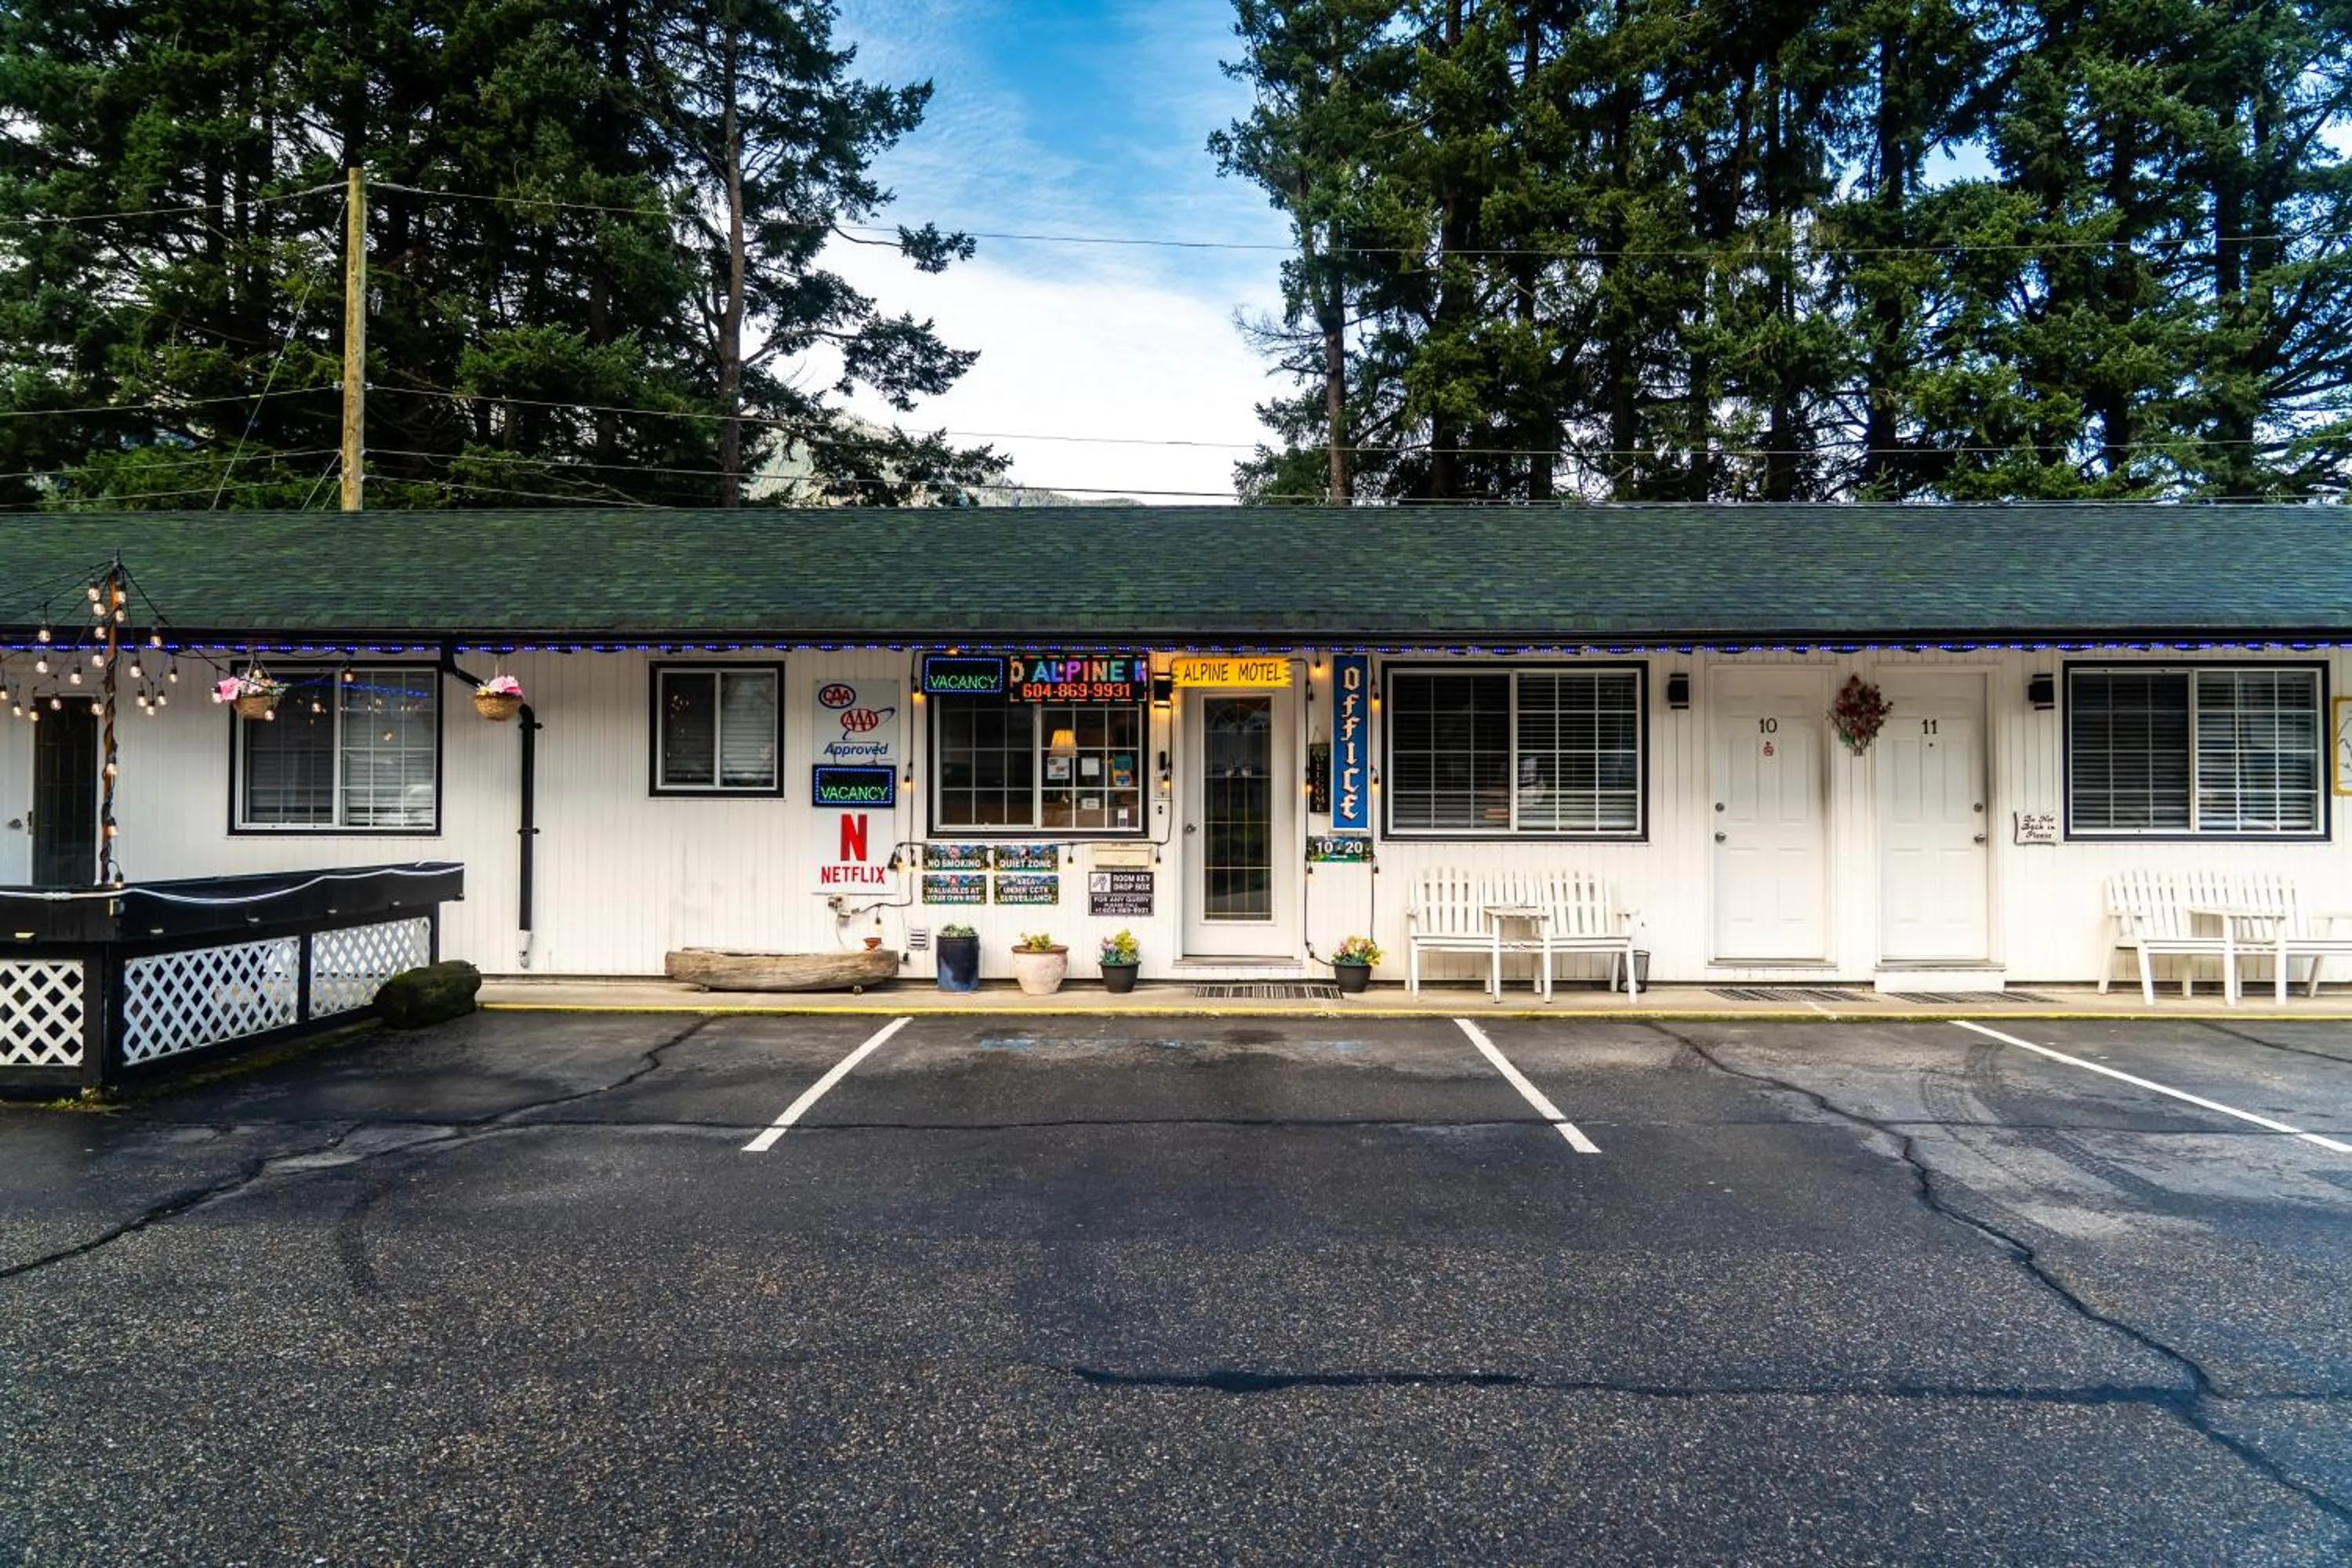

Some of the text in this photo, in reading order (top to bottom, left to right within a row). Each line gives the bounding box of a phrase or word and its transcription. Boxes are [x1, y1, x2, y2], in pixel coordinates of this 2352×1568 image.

[1031, 661, 1124, 682] ALPINE
[1183, 662, 1281, 681] ALPINE MOTEL
[929, 675, 998, 689] VACANCY
[1022, 683, 1131, 697] 604-869-9931
[822, 688, 851, 704] CAA
[841, 709, 878, 731] AAA
[1759, 717, 1778, 733] 10
[1922, 719, 1938, 735] 11
[823, 742, 889, 757] Approved
[821, 786, 888, 800] VACANCY
[840, 813, 868, 861] N
[1316, 841, 1333, 853] 10
[1345, 841, 1363, 853] 20
[942, 859, 981, 868] SMOKING
[1000, 859, 1052, 868] QUIET ZONE
[821, 866, 886, 884] NETFLIX
